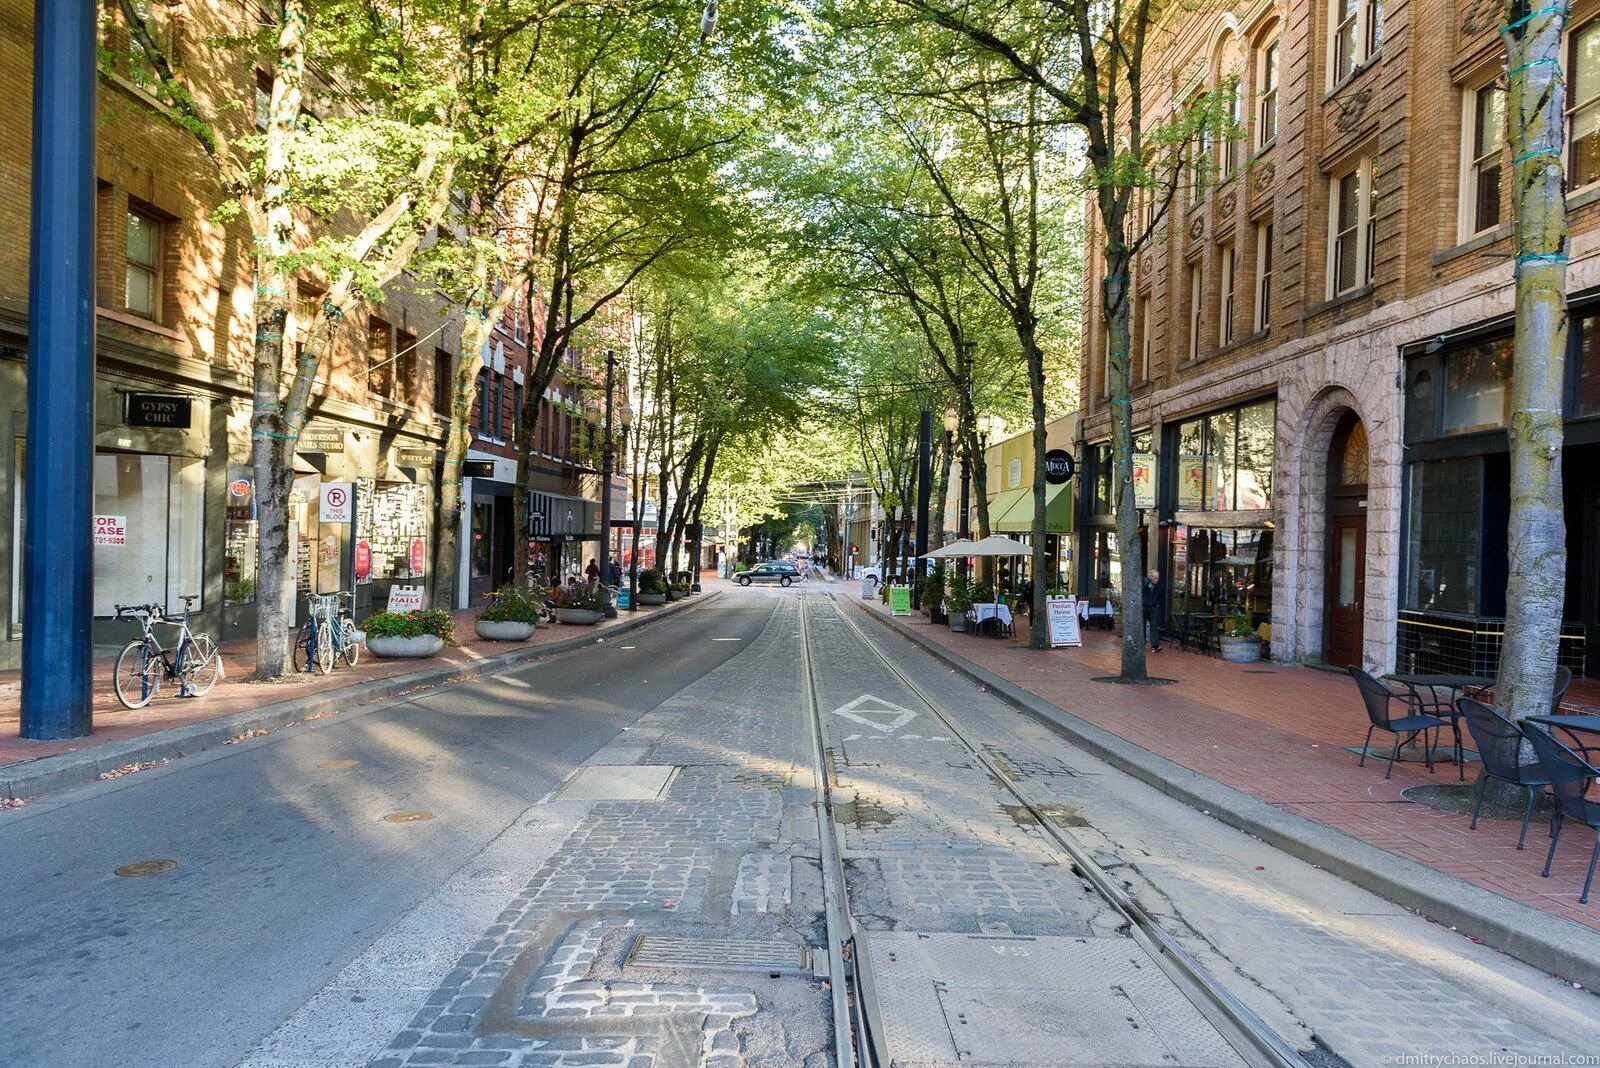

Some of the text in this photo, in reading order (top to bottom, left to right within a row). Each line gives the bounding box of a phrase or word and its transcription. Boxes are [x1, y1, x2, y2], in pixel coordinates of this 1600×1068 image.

[141, 401, 178, 412] GYPSY
[145, 412, 175, 423] CHIC
[318, 441, 344, 450] STUDIO
